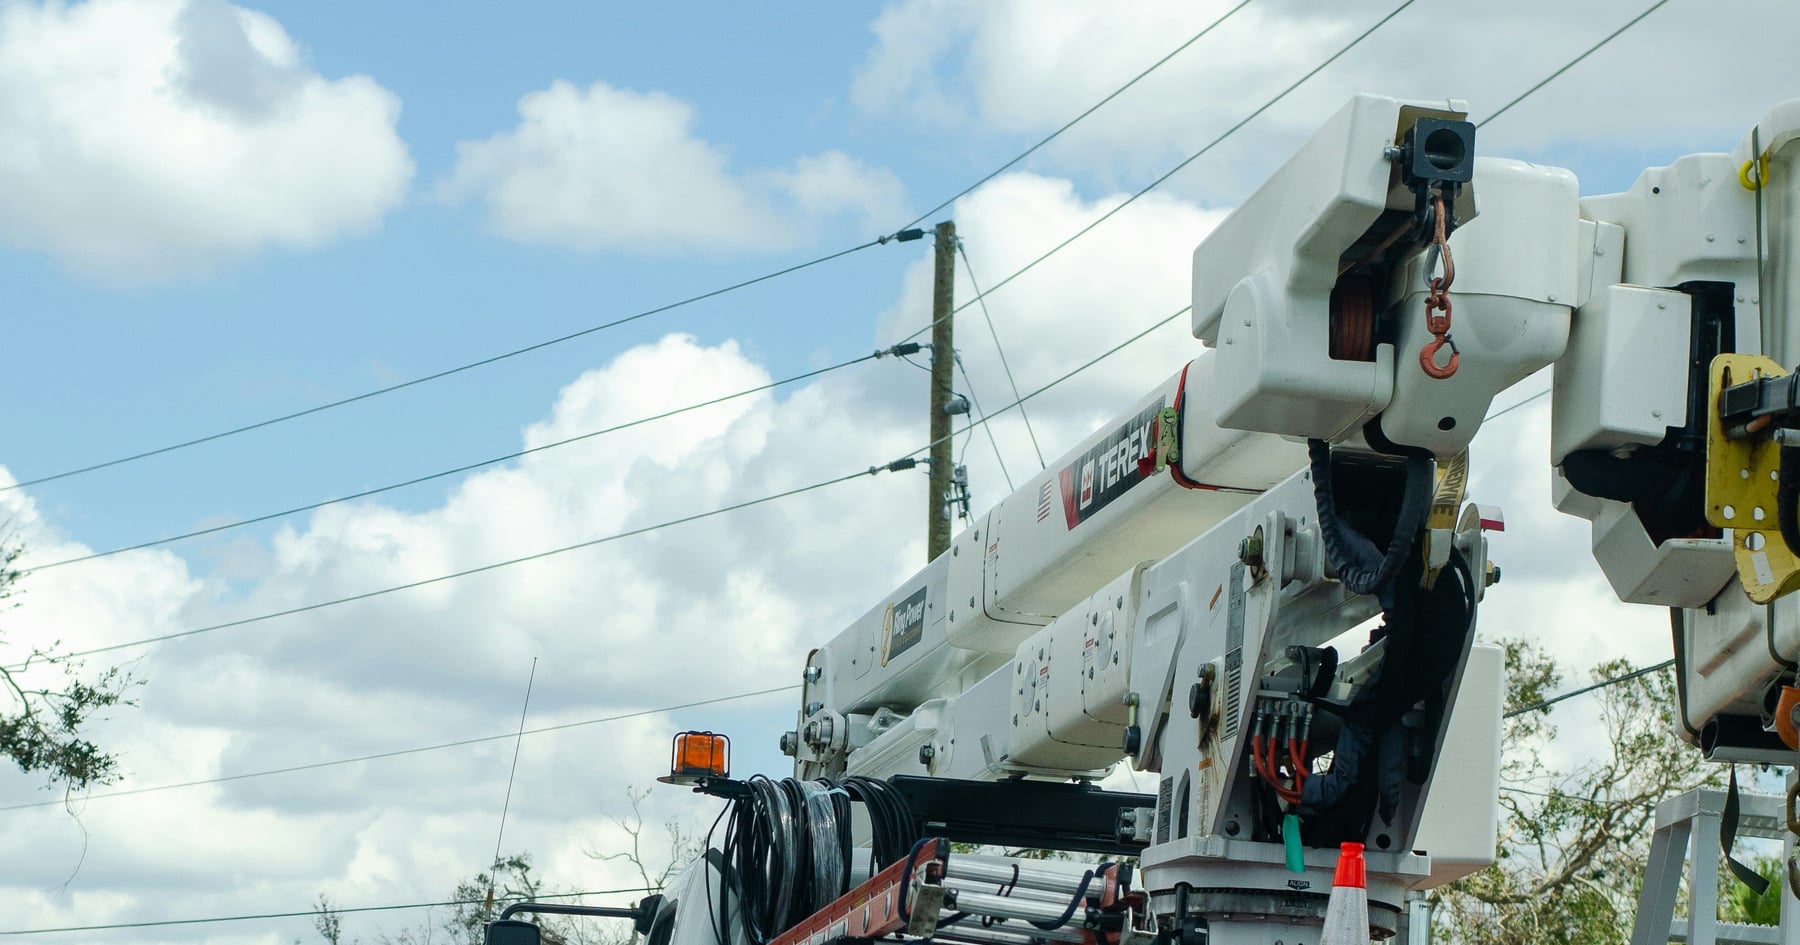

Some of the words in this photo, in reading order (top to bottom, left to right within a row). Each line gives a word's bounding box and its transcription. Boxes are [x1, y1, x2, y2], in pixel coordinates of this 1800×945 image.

[1099, 420, 1151, 493] TEREX
[892, 609, 906, 636] Ring
[905, 600, 924, 628] Power
